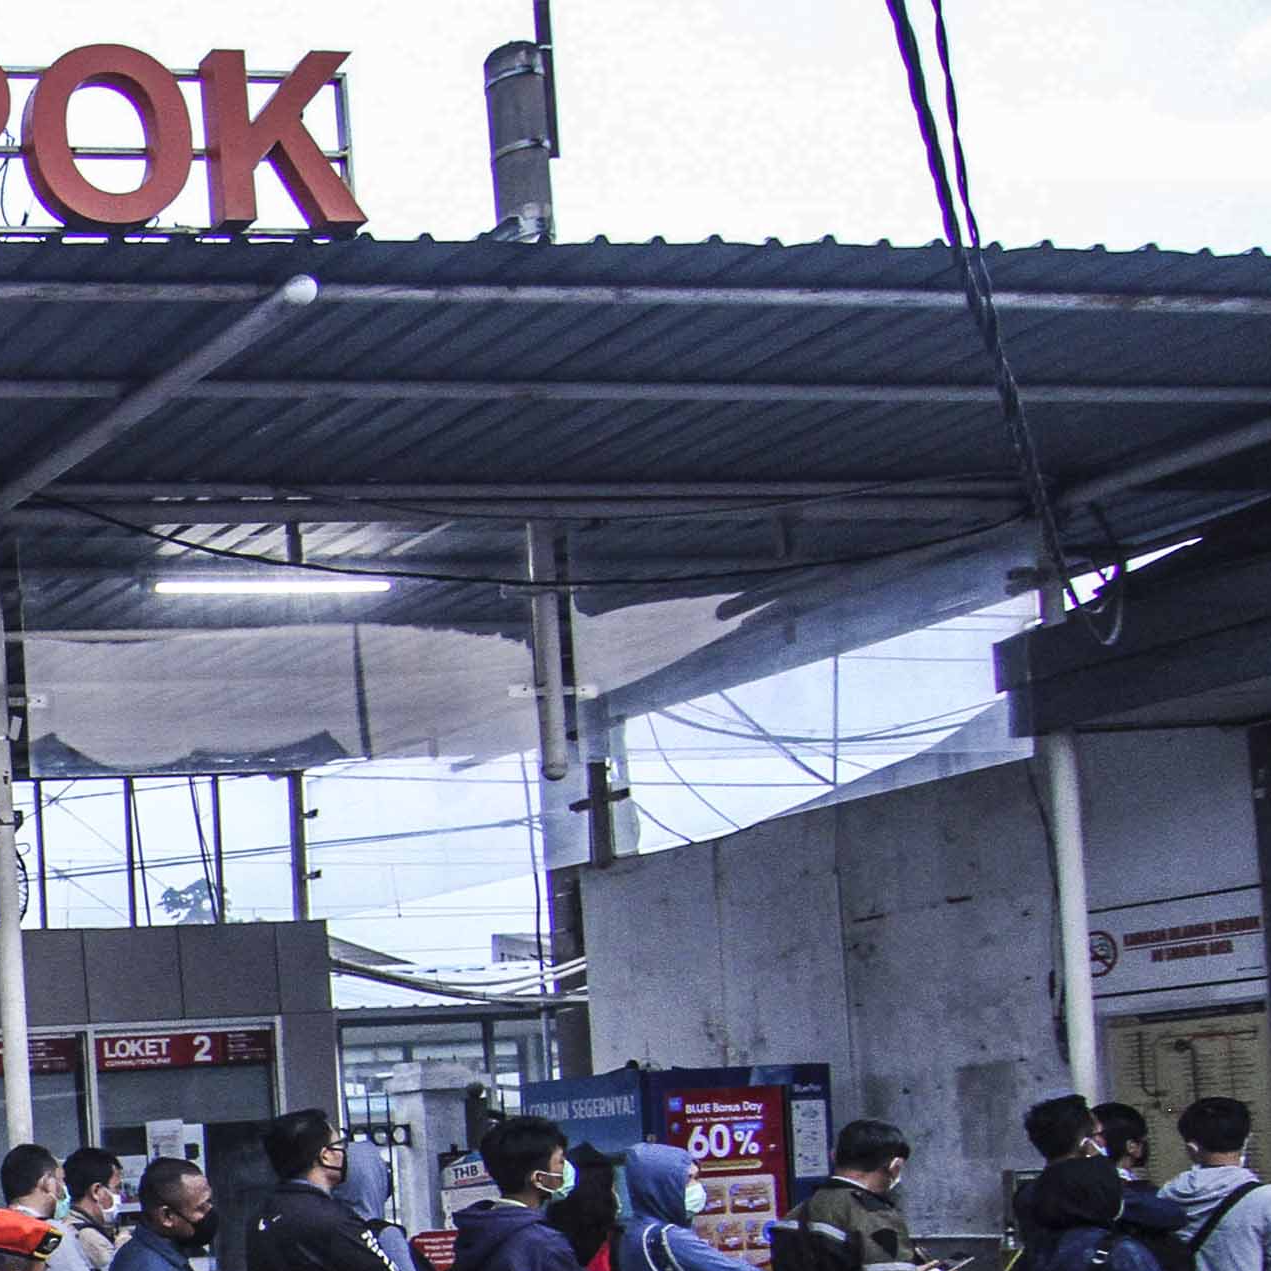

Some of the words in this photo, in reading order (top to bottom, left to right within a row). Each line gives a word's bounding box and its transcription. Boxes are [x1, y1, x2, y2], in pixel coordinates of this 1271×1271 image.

[103, 1037, 171, 1059] LOKET
[192, 1034, 213, 1062] 2
[685, 1103, 711, 1114] BLUE
[713, 1101, 741, 1113] Bonus
[742, 1100, 764, 1114] Day
[687, 1123, 760, 1159] 60%
[452, 1165, 479, 1180] THB
